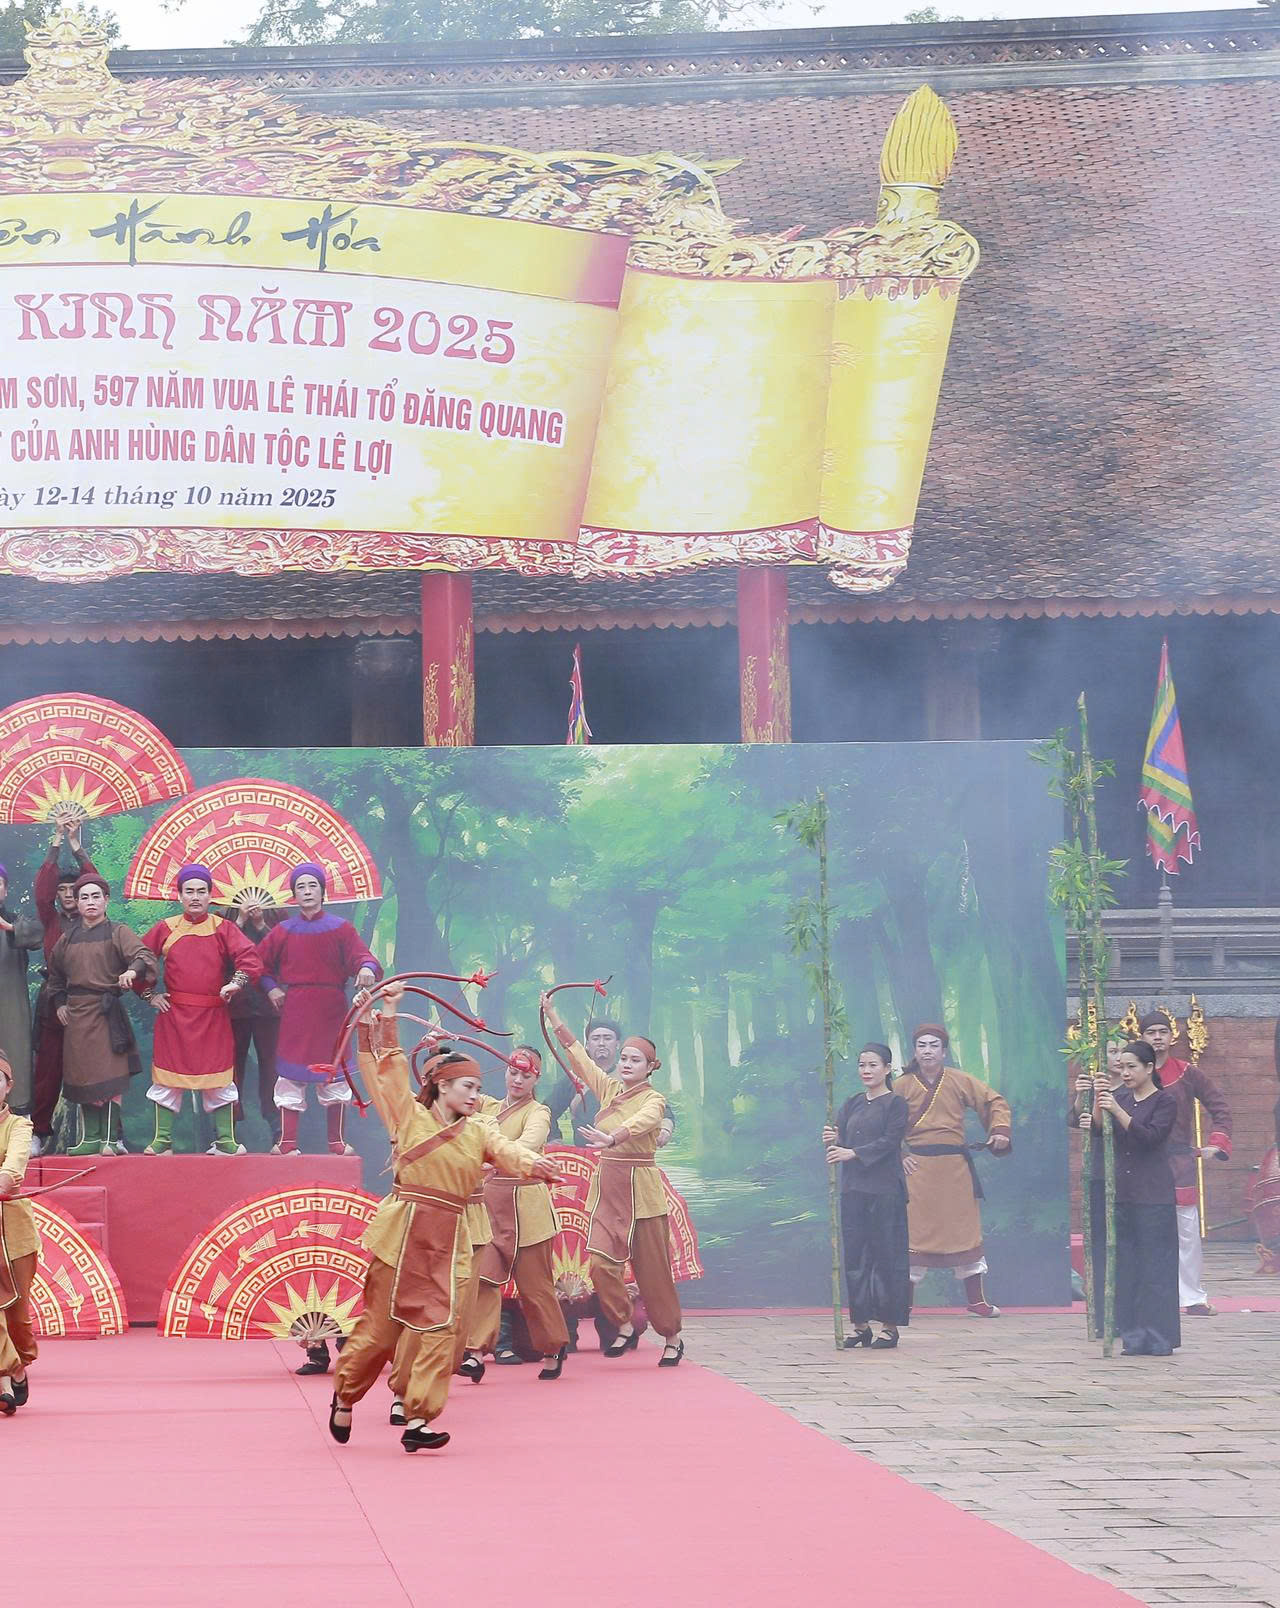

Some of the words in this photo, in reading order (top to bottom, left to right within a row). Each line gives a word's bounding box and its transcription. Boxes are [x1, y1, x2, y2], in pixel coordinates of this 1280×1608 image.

[279, 199, 381, 271] Hóa
[14, 292, 176, 350] KINH
[197, 286, 353, 347] NĂM
[368, 306, 517, 364] 2025
[26, 374, 86, 411] SƠN,
[93, 375, 139, 407] 597
[146, 370, 204, 408] NĂM
[213, 378, 258, 411] VUA
[267, 375, 294, 413] LÊ
[303, 377, 357, 419] THÁI
[366, 377, 398, 422] TỔ
[403, 387, 472, 431] ĐĂNG
[479, 402, 564, 444] QUANG
[11, 419, 59, 461] CỦA
[69, 428, 120, 461] ANH
[128, 421, 196, 463] HÙNG
[204, 424, 255, 465] DÂN
[263, 427, 310, 474] TỘC
[319, 430, 346, 471] LÊ
[353, 439, 392, 480] LỢI
[33, 486, 95, 507] 12-14
[104, 484, 178, 510] tháng
[184, 486, 211, 505] 10
[219, 487, 273, 508] năm
[280, 489, 336, 508] 2025
